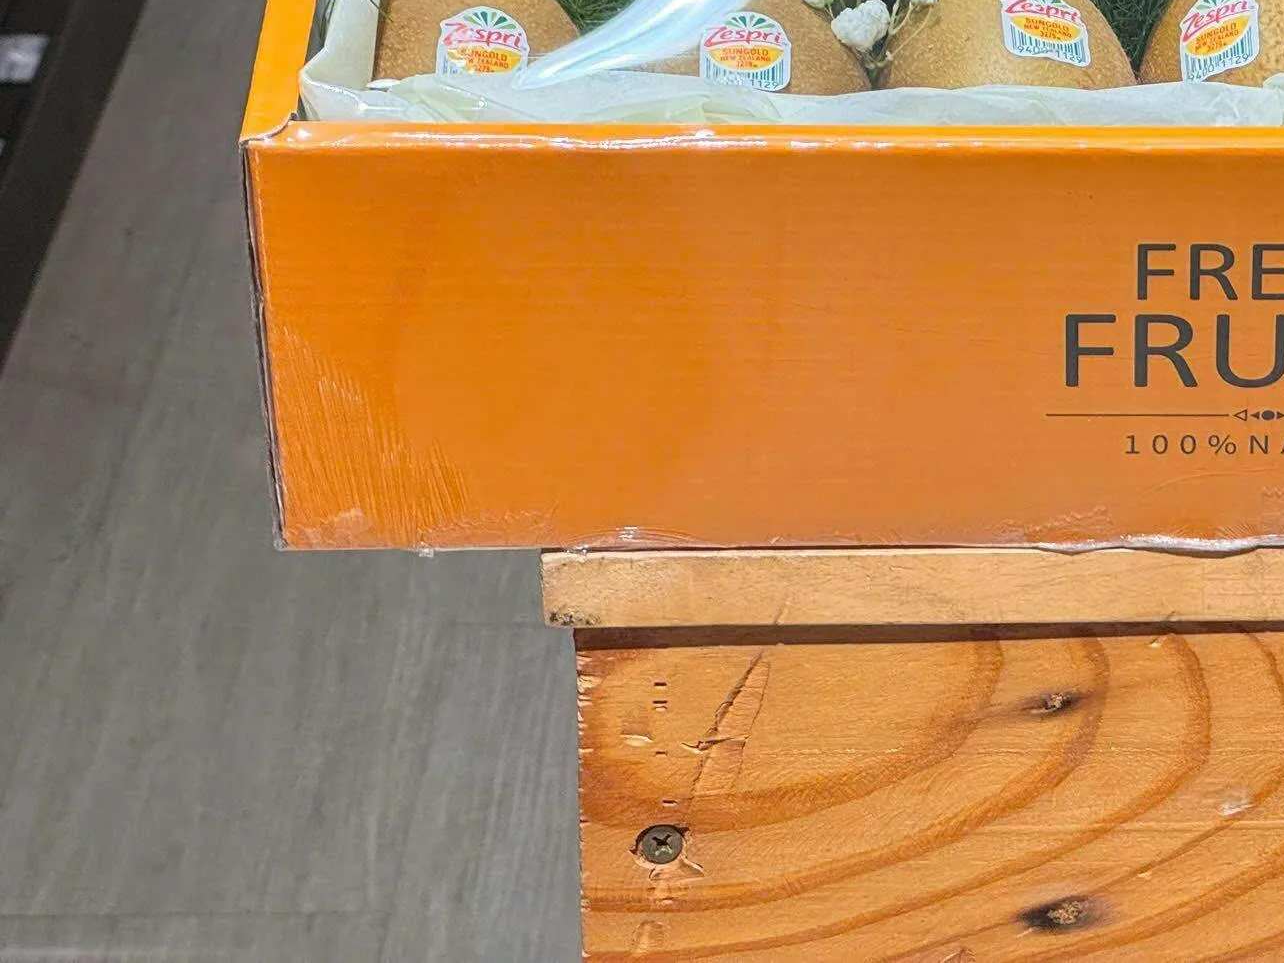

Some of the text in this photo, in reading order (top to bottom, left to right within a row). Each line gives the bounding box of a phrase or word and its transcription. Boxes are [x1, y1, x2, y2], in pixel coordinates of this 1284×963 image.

[443, 23, 523, 48] Zspri
[1025, 17, 1070, 33] SUNGOLD
[1196, 22, 1237, 45] SUNGOLD
[704, 26, 782, 48] Zespri
[722, 47, 769, 56] SUNGOLD
